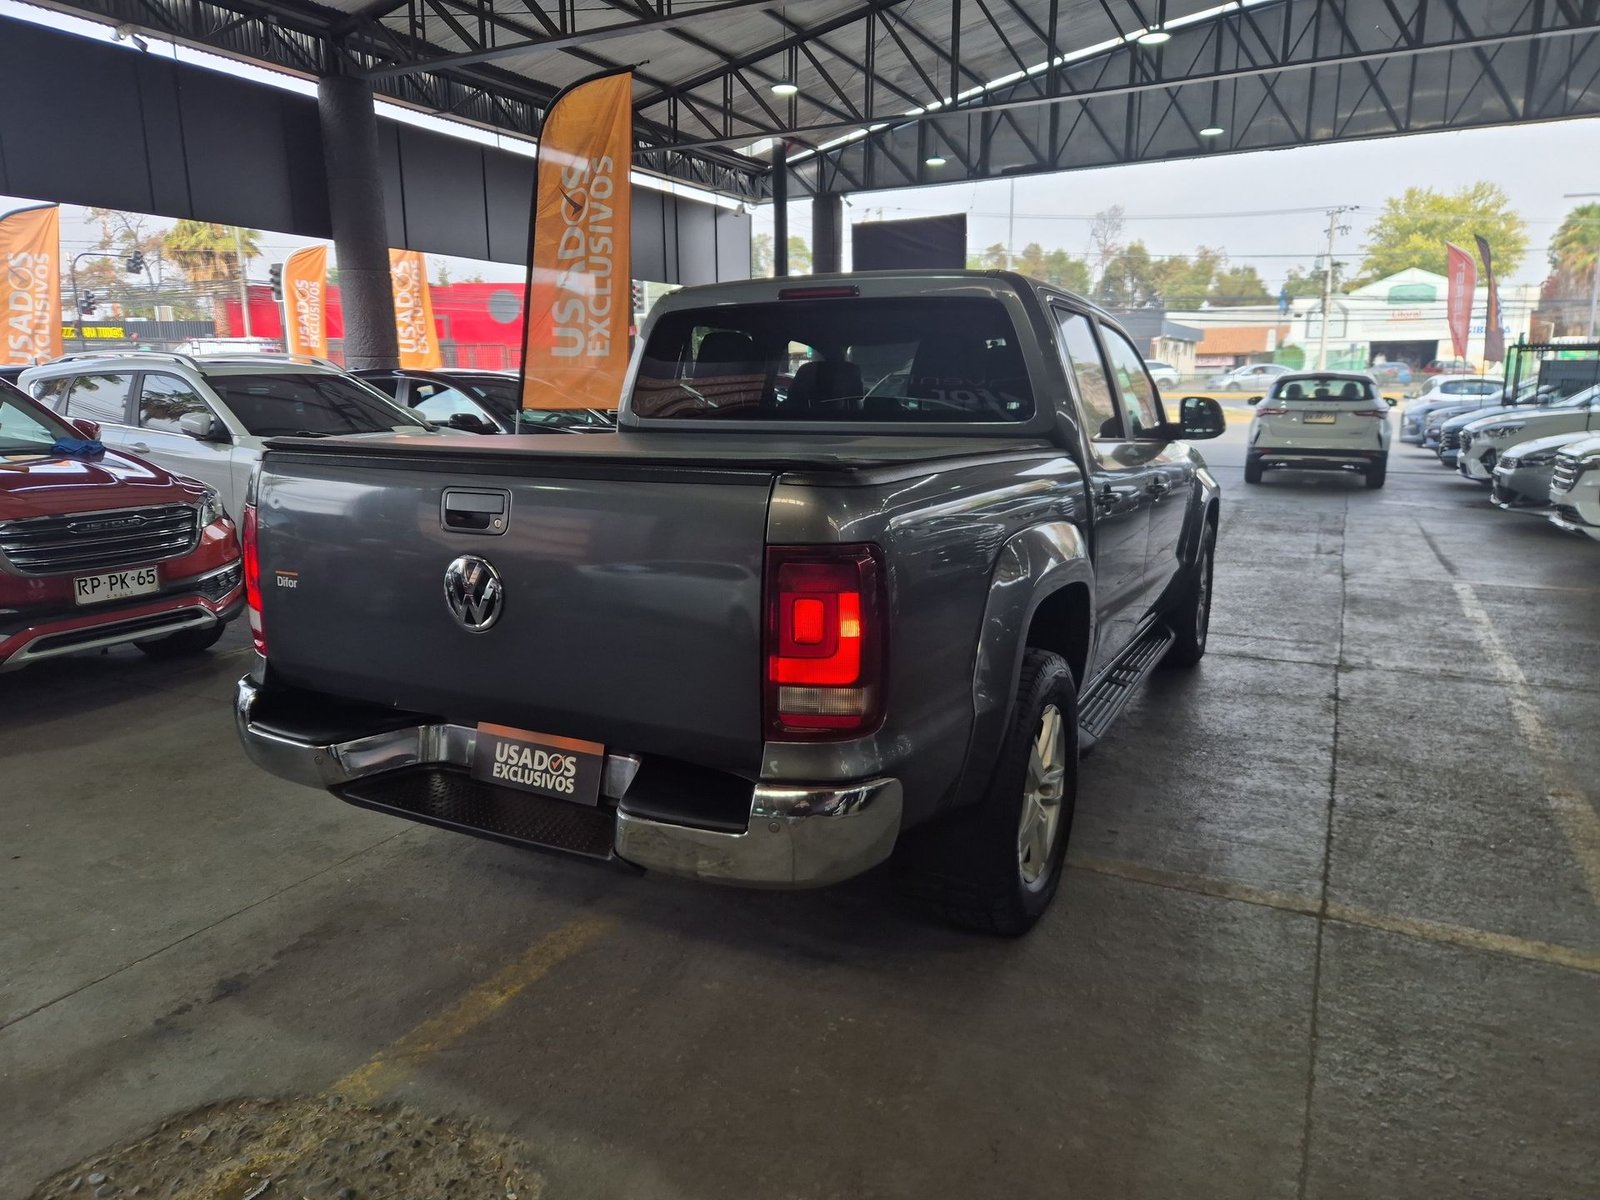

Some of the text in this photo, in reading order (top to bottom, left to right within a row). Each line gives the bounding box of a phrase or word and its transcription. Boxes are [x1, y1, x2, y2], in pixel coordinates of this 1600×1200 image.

[551, 164, 591, 357] USADOS
[586, 154, 613, 357] EXCLUSIVOS
[32, 252, 50, 364] XCLUSIVOS
[295, 279, 311, 347] USADOS
[309, 281, 321, 348] EXCLUSIVOS
[391, 260, 418, 353] USADOS
[409, 259, 430, 354] EXCLUSIVOS
[276, 575, 298, 589] Difor
[492, 762, 575, 794] EXCLUSIVOS
[495, 742, 577, 777] USADOS
